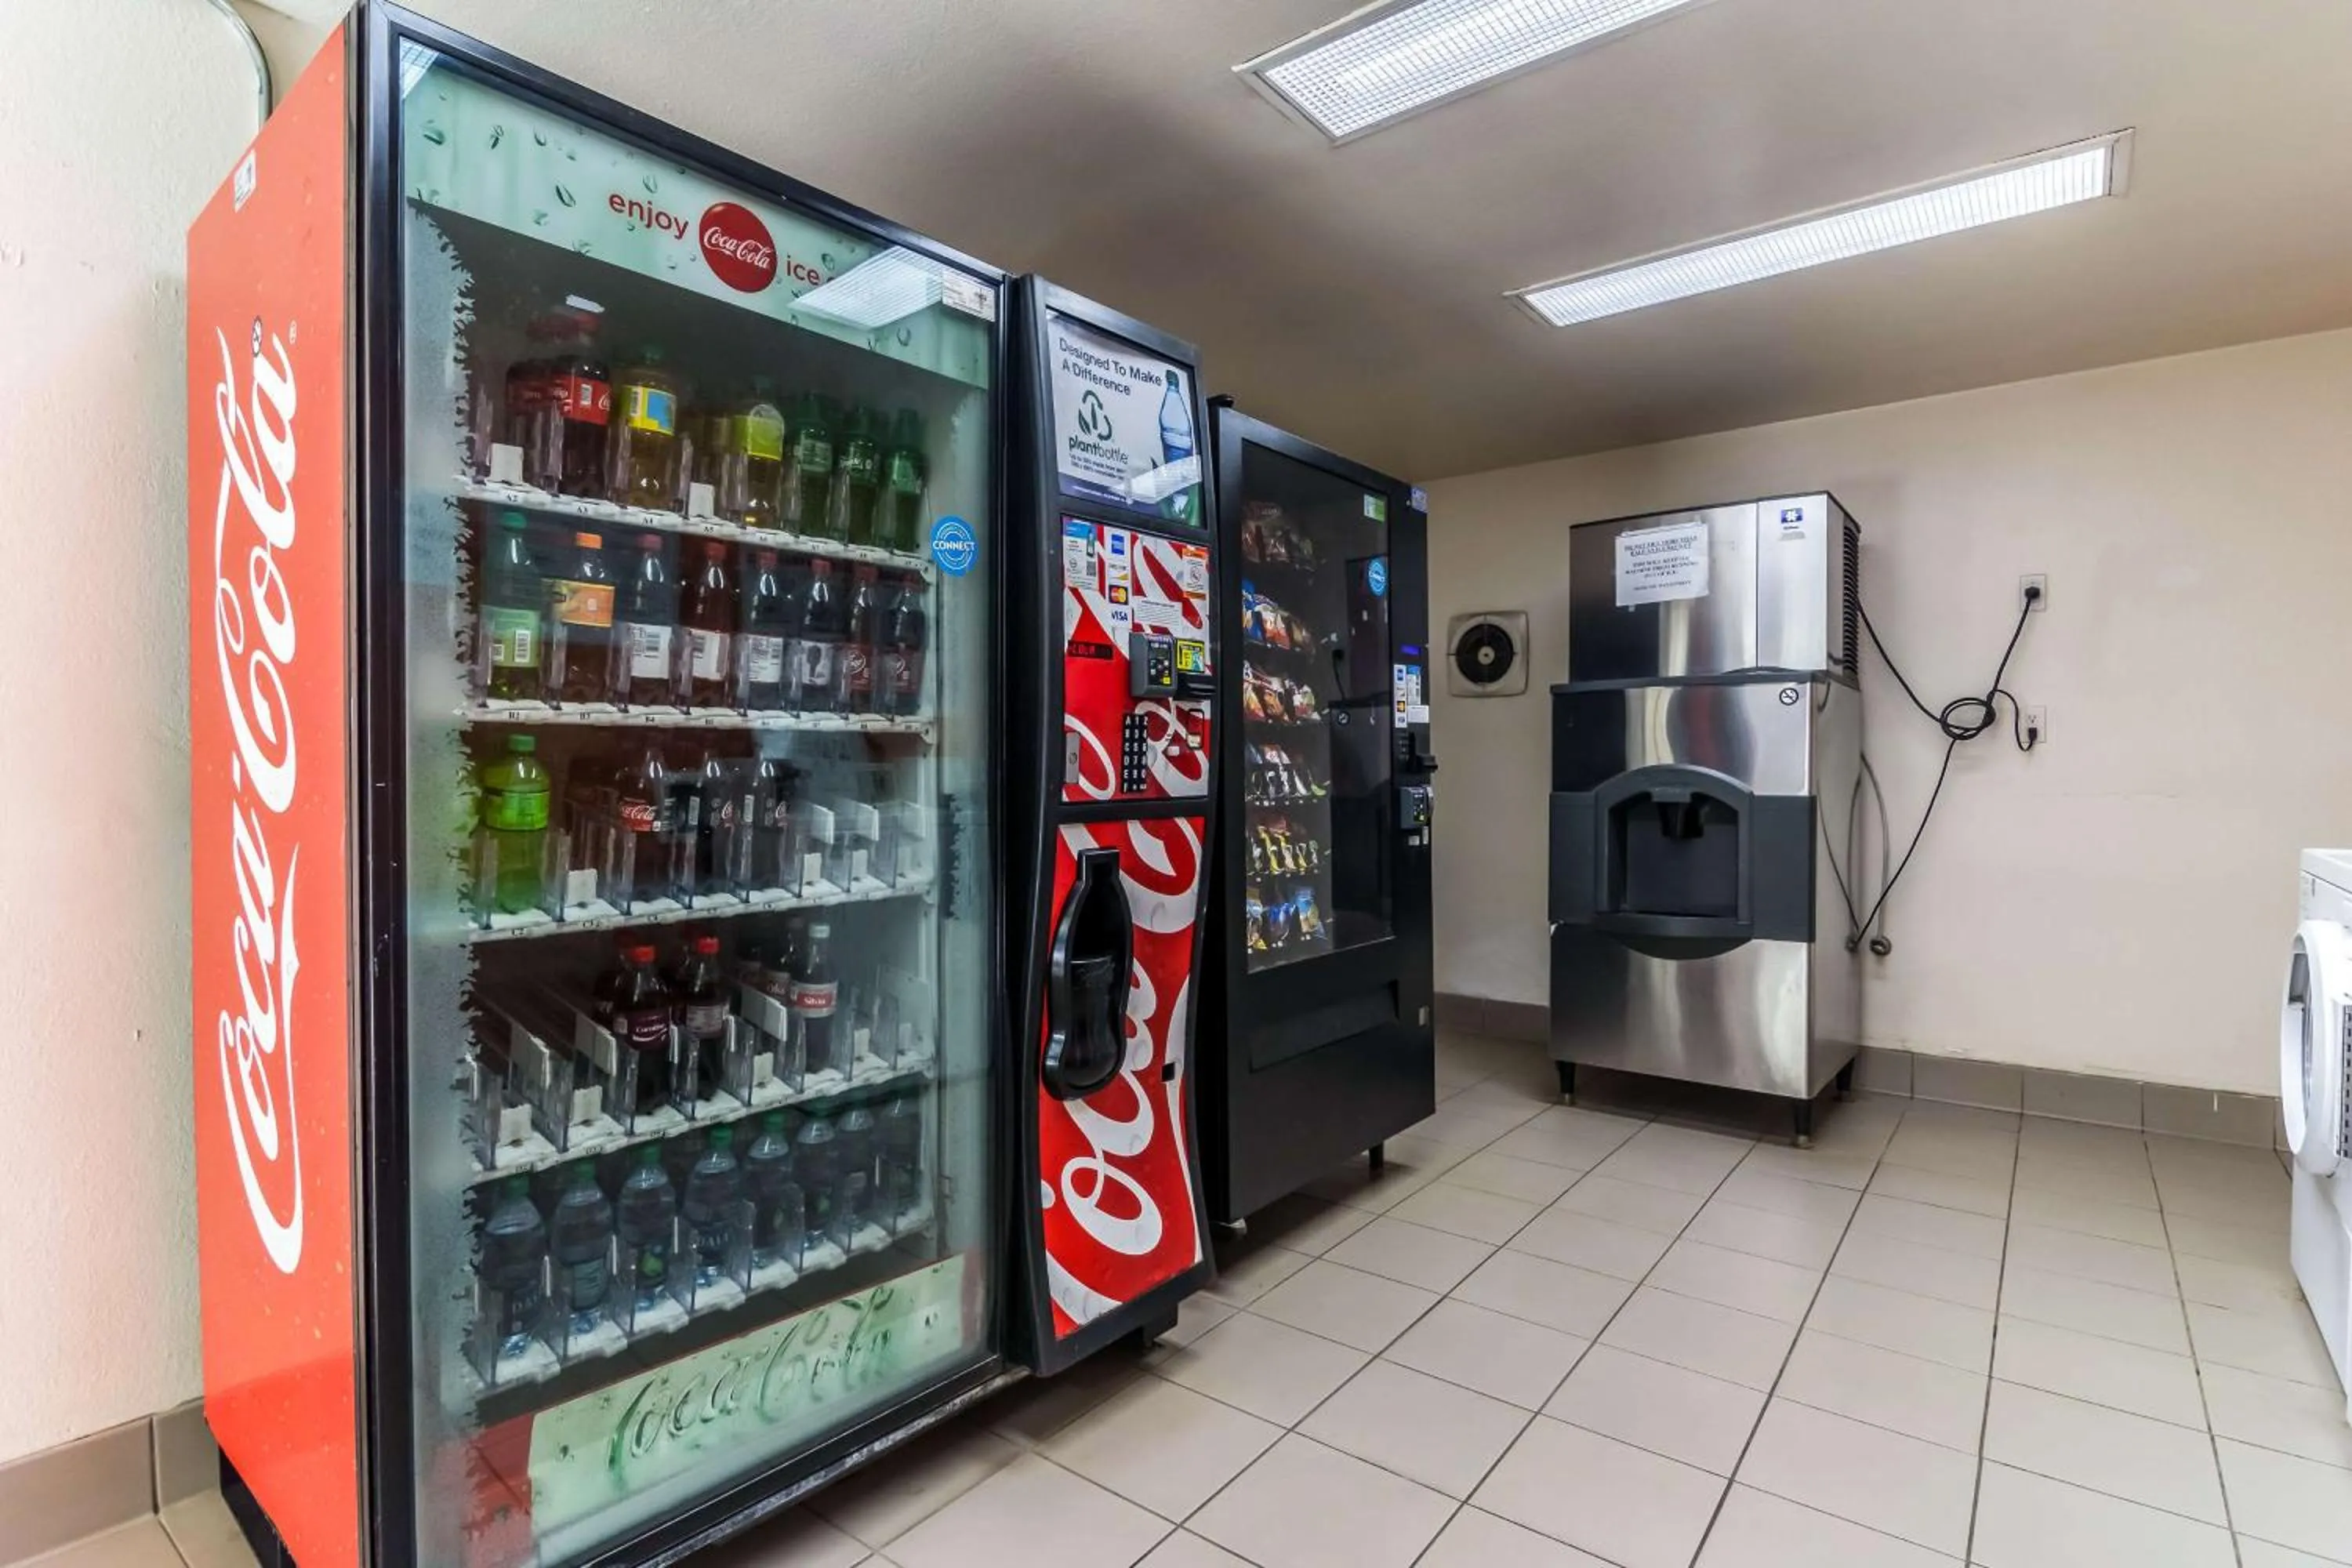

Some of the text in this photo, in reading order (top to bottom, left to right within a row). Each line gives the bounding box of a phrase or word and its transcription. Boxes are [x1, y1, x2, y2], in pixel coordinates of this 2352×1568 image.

[608, 191, 820, 285] enjoy Coca-Cola ice
[1059, 337, 1162, 387] Designed To Make
[1062, 358, 1131, 396] A Difference
[1069, 434, 1129, 465] plantbottle
[933, 540, 975, 551] CONNECT
[1111, 611, 1128, 621] VISA
[215, 325, 303, 1274] Coca-Cola
